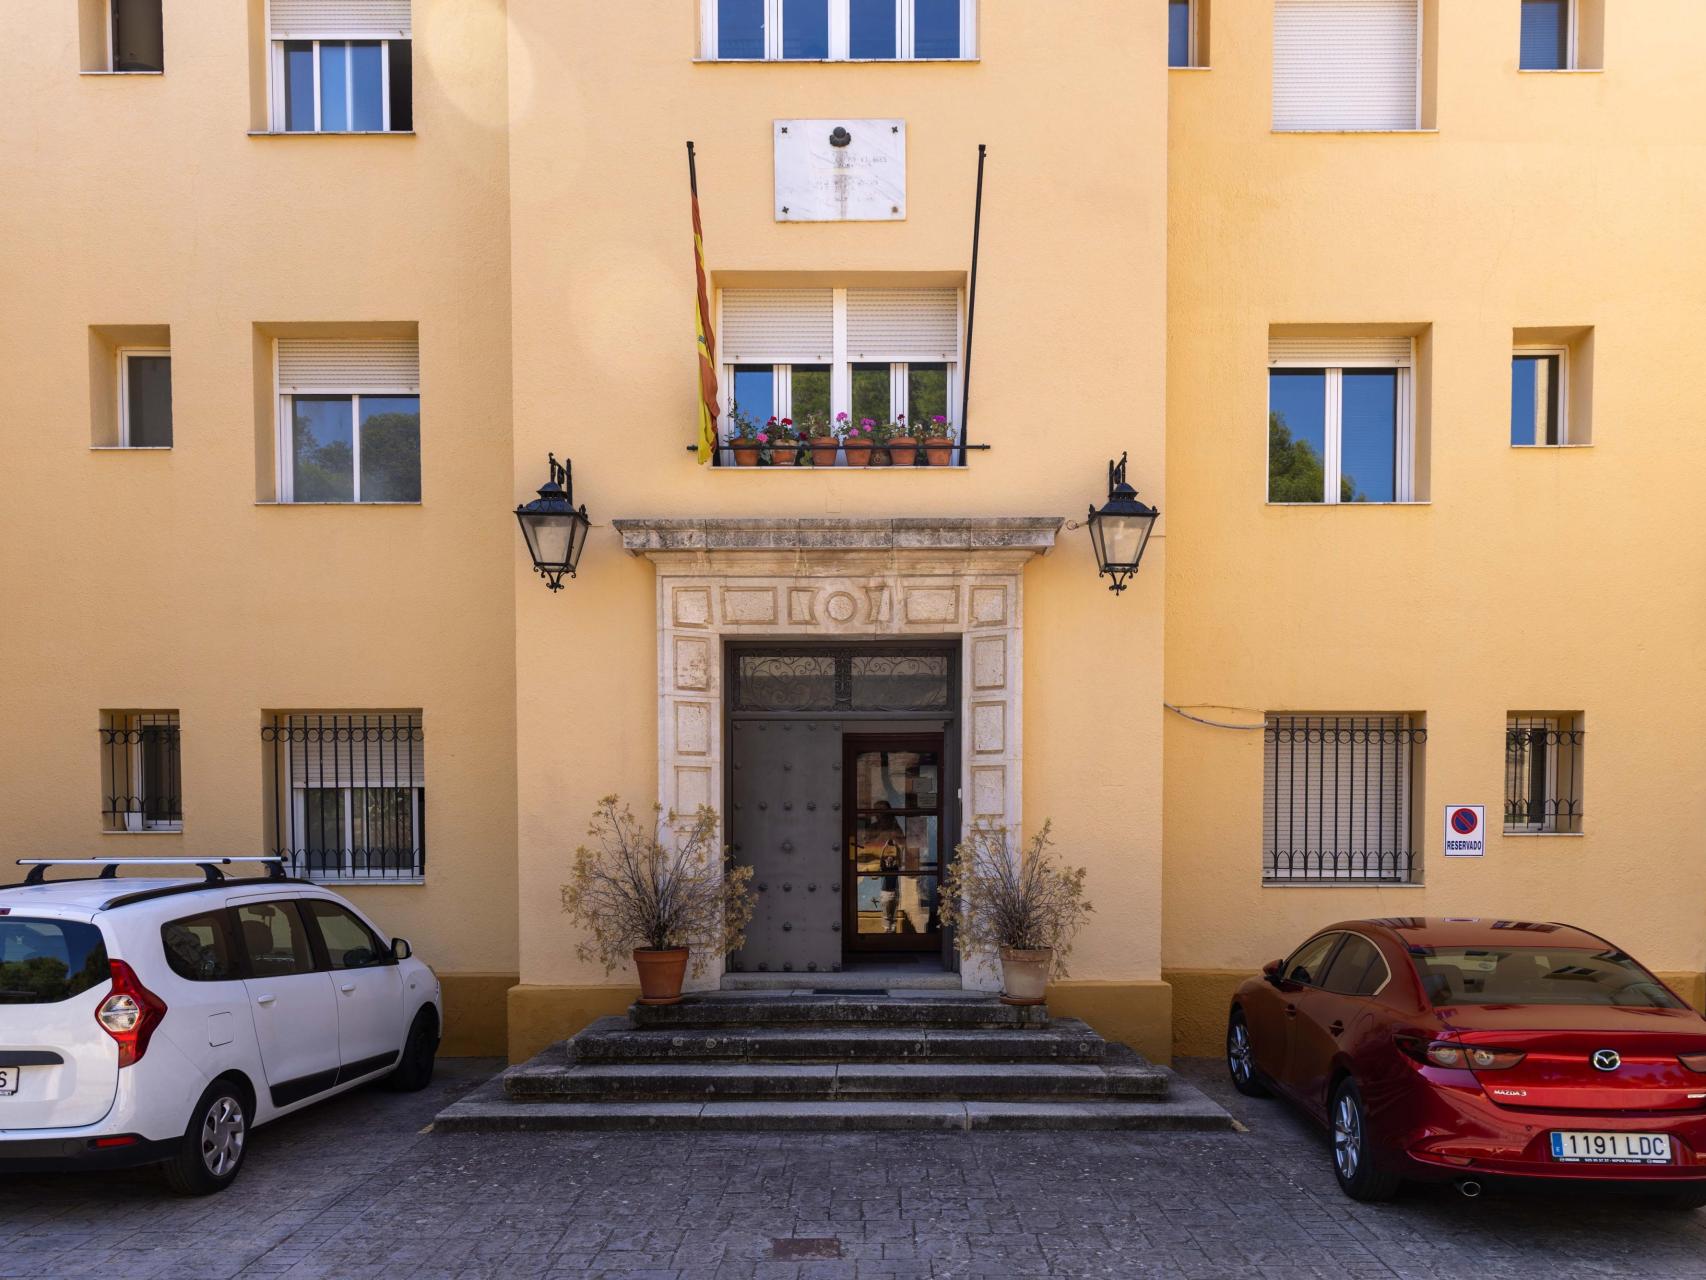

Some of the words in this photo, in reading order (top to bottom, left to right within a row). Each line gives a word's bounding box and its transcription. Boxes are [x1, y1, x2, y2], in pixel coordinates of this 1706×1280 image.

[1447, 840, 1481, 850] RESERVADO
[1569, 1135, 1617, 1154] 1191
[1626, 1136, 1665, 1155] LDC
